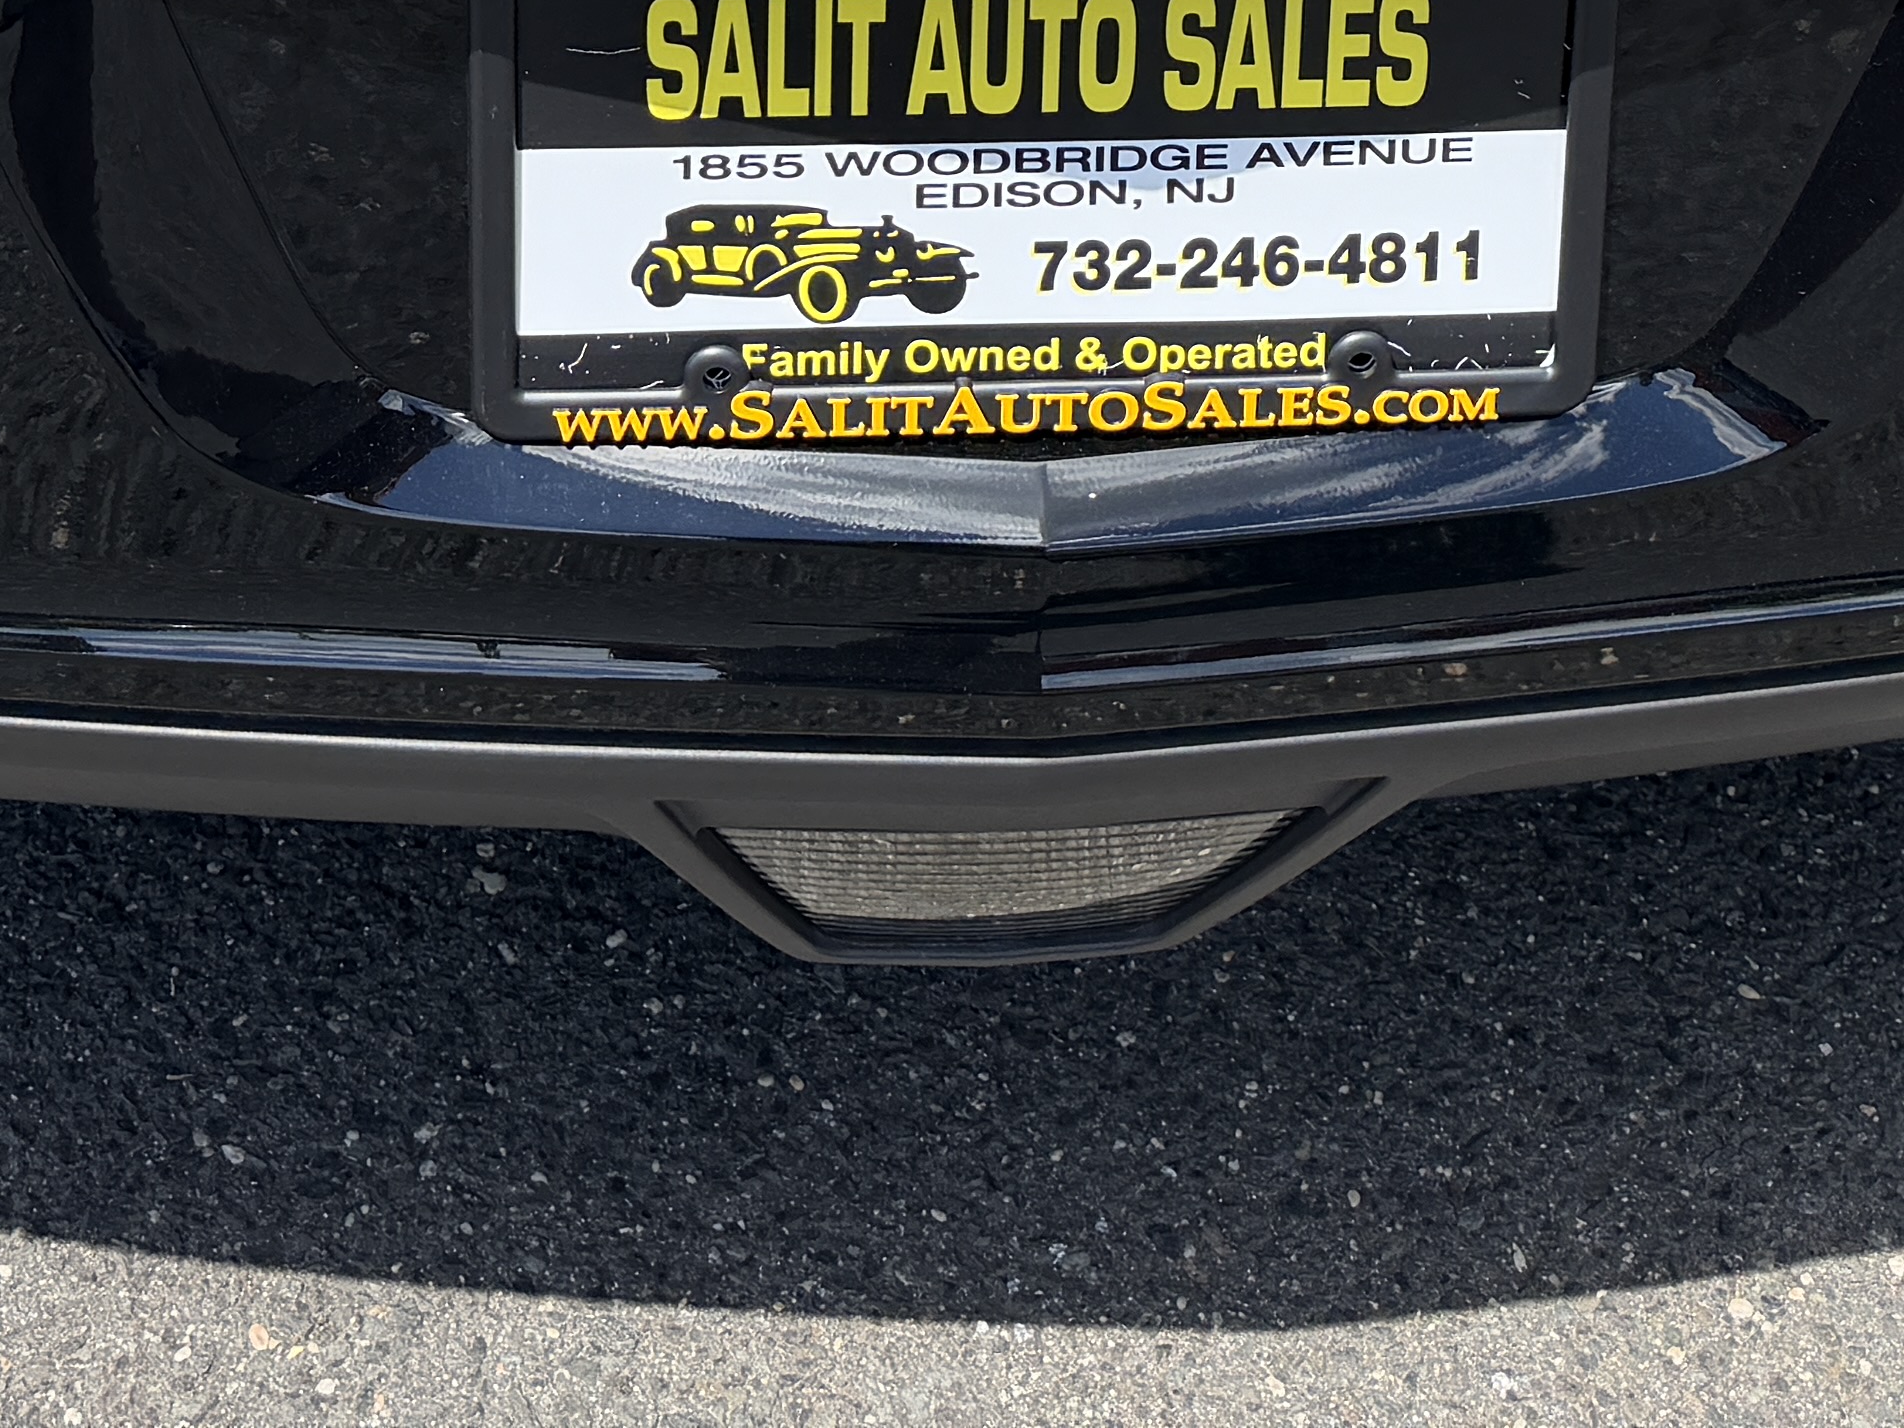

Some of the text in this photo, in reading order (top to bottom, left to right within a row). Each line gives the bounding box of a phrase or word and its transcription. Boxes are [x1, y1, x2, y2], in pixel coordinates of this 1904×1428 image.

[671, 136, 1474, 182] 1855 WOODBRIDGE AVENUE
[914, 176, 1236, 210] EDISON, NJ
[1031, 229, 1482, 292] 732-246-4811
[742, 332, 1327, 384] Family Owned & Operated
